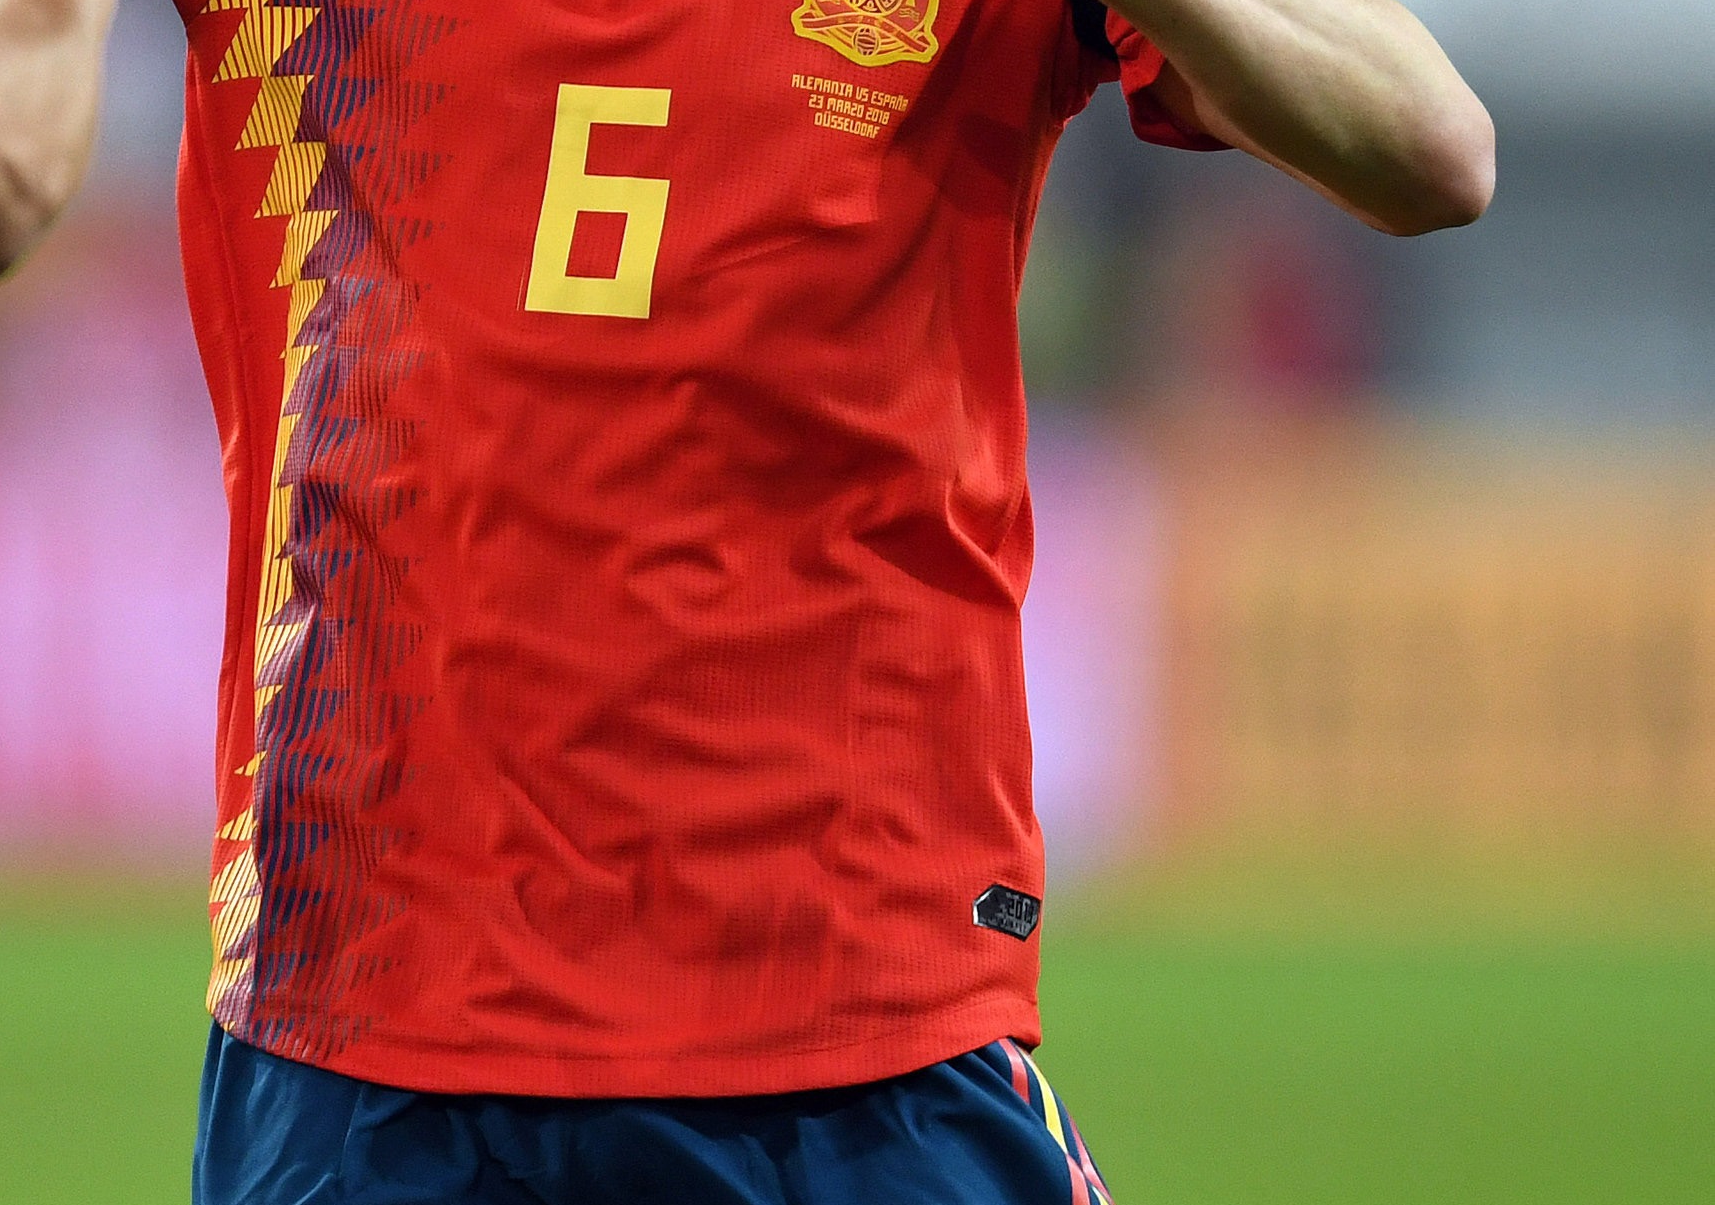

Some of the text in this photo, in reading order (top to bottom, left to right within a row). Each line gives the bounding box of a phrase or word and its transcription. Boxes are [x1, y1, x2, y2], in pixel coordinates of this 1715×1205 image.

[791, 74, 854, 98] ALEMANIA
[808, 94, 890, 125] 23 MARZO 2018
[814, 111, 880, 139] DÜSSELDORF
[525, 83, 672, 319] 6
